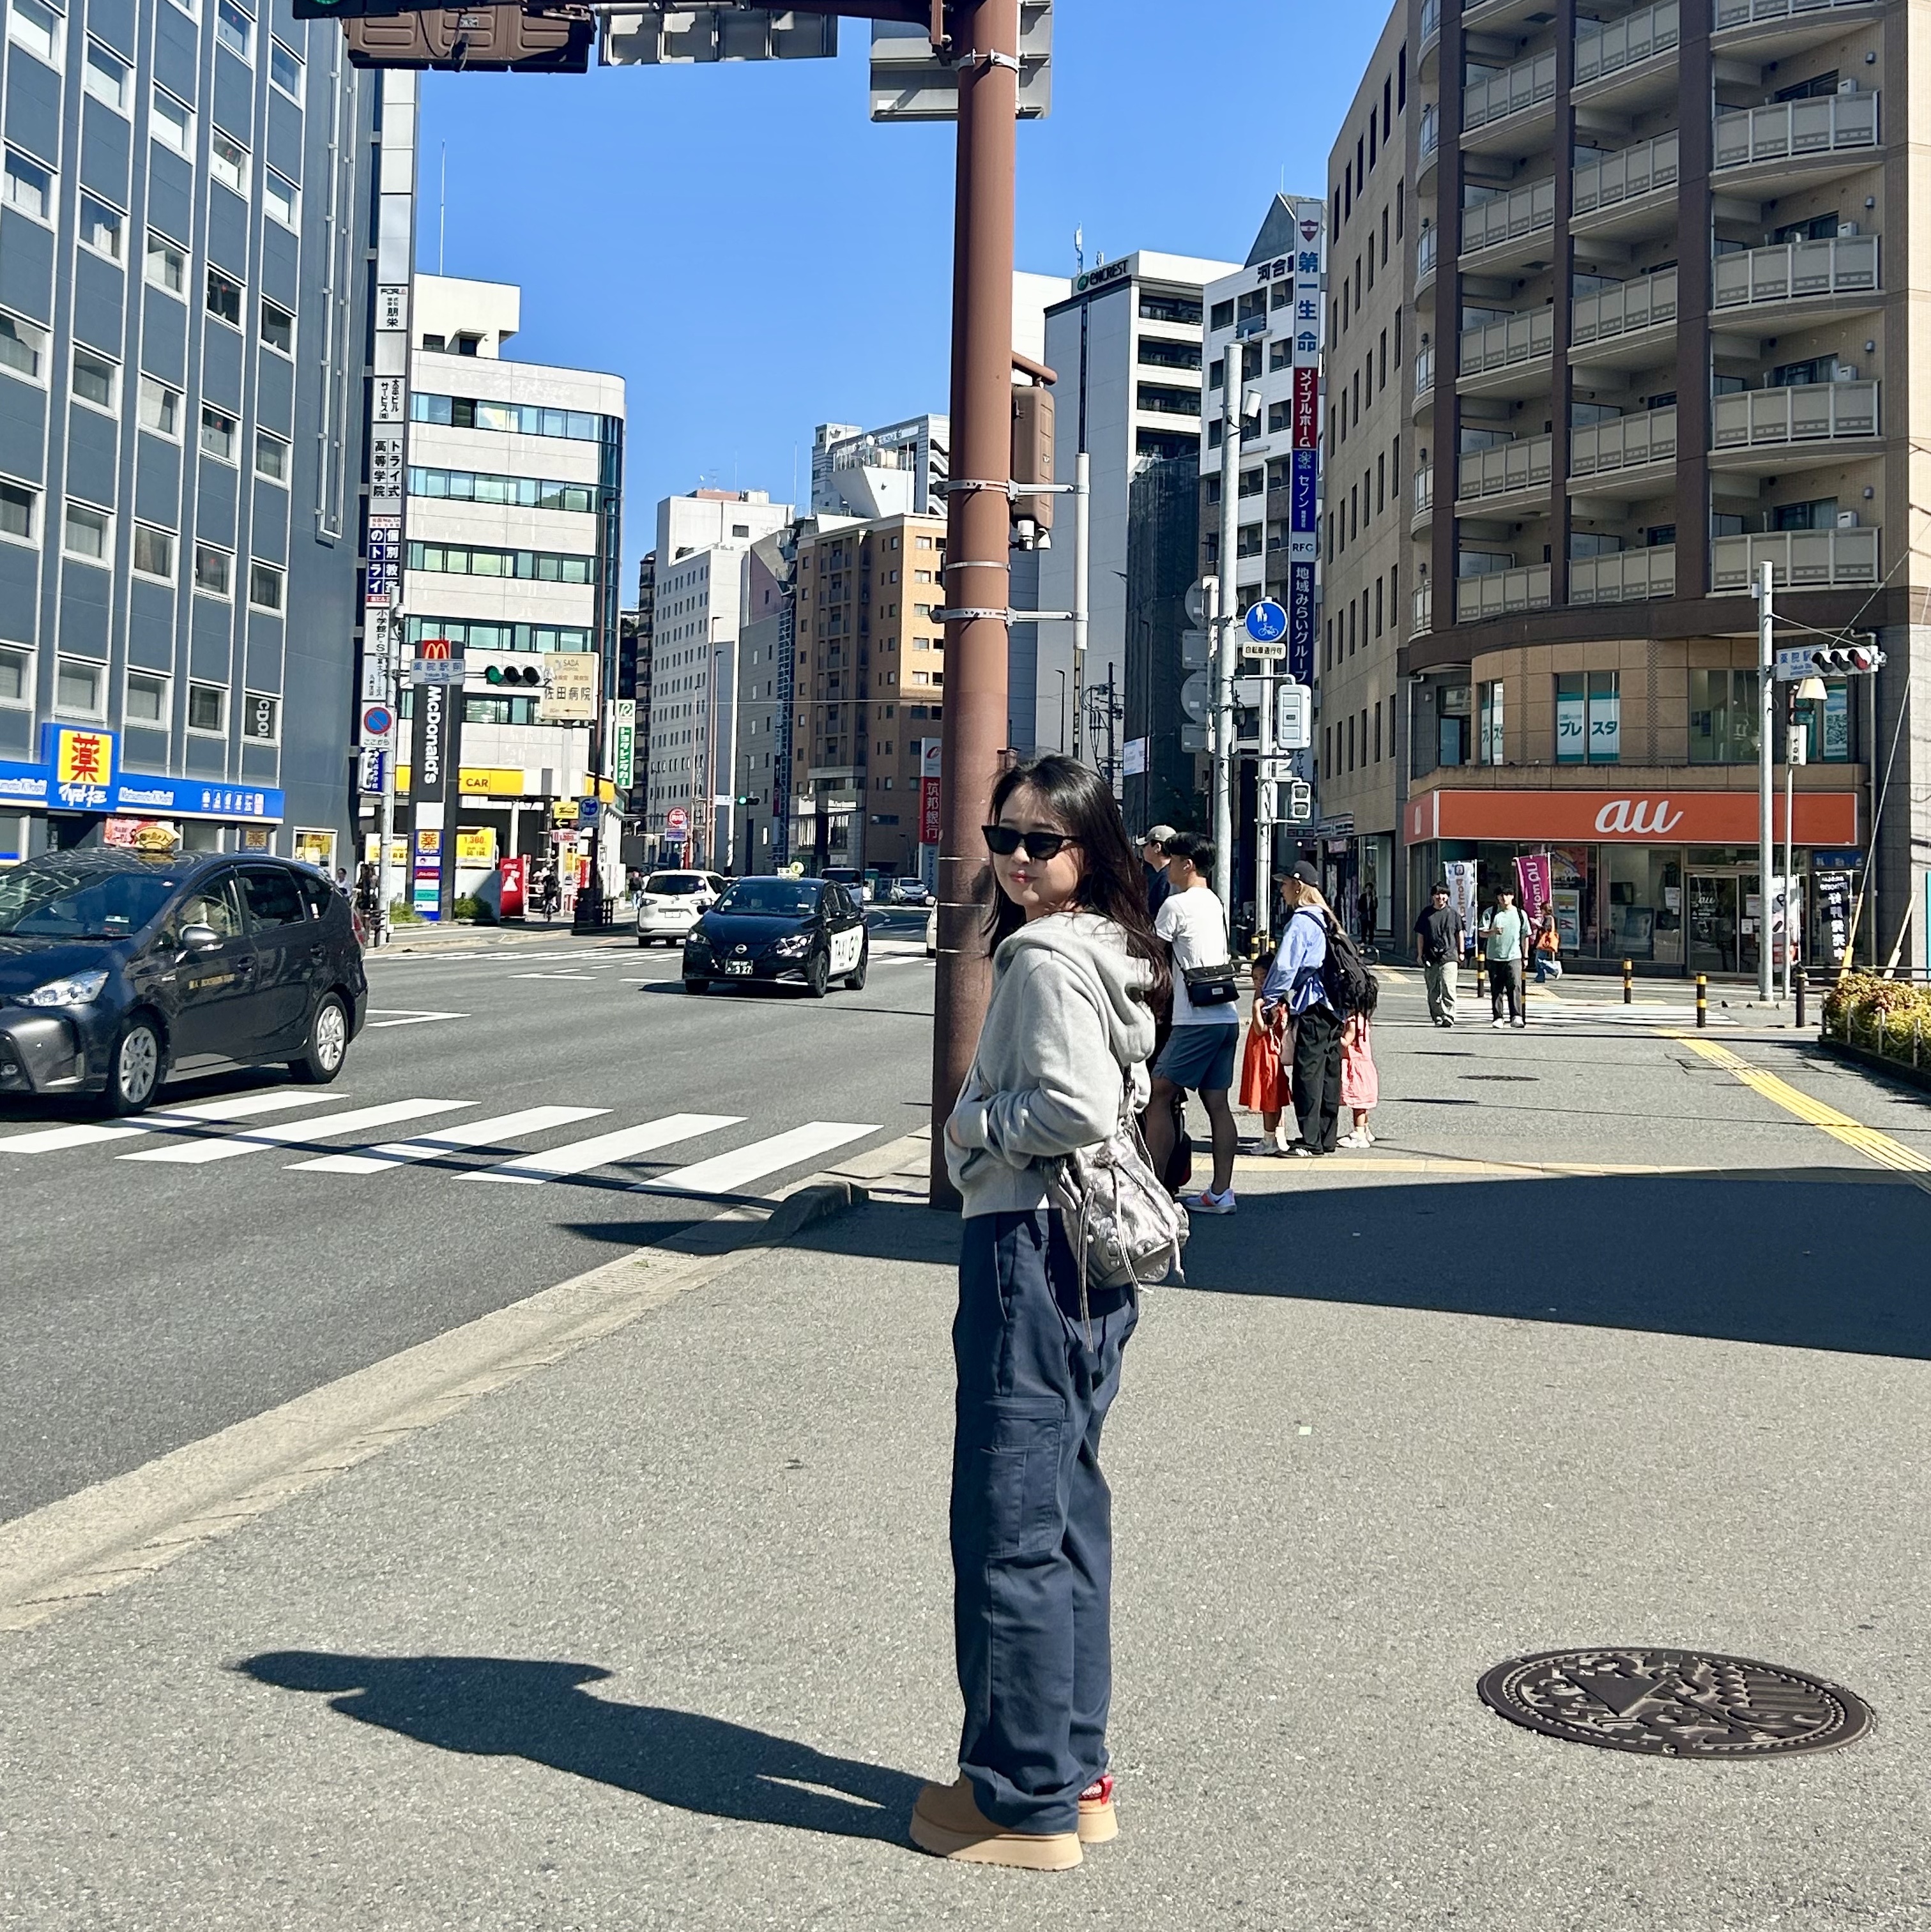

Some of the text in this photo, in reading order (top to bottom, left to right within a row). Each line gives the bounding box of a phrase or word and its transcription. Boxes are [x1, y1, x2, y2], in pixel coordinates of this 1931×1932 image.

[1090, 259, 1128, 285] ENCREST
[1297, 251, 1318, 352] 第一生命
[1299, 369, 1312, 448] メイプルホーム
[374, 440, 387, 498] 高等学院
[388, 440, 401, 498] トライ式
[1299, 475, 1310, 508] セノン
[370, 529, 384, 593] のトライ
[1245, 646, 1283, 655] 自転車通行可
[1295, 567, 1309, 683] 地域みらいグループ
[1780, 649, 1822, 664] 薬院駅
[544, 687, 591, 701] 佐田病院
[71, 733, 100, 783] 薬
[424, 685, 442, 785] McDonald's
[619, 727, 630, 786] トヨタレンタカー
[466, 778, 489, 787] CAR
[926, 782, 940, 839] 筑邦銀行
[1594, 800, 1684, 833] au
